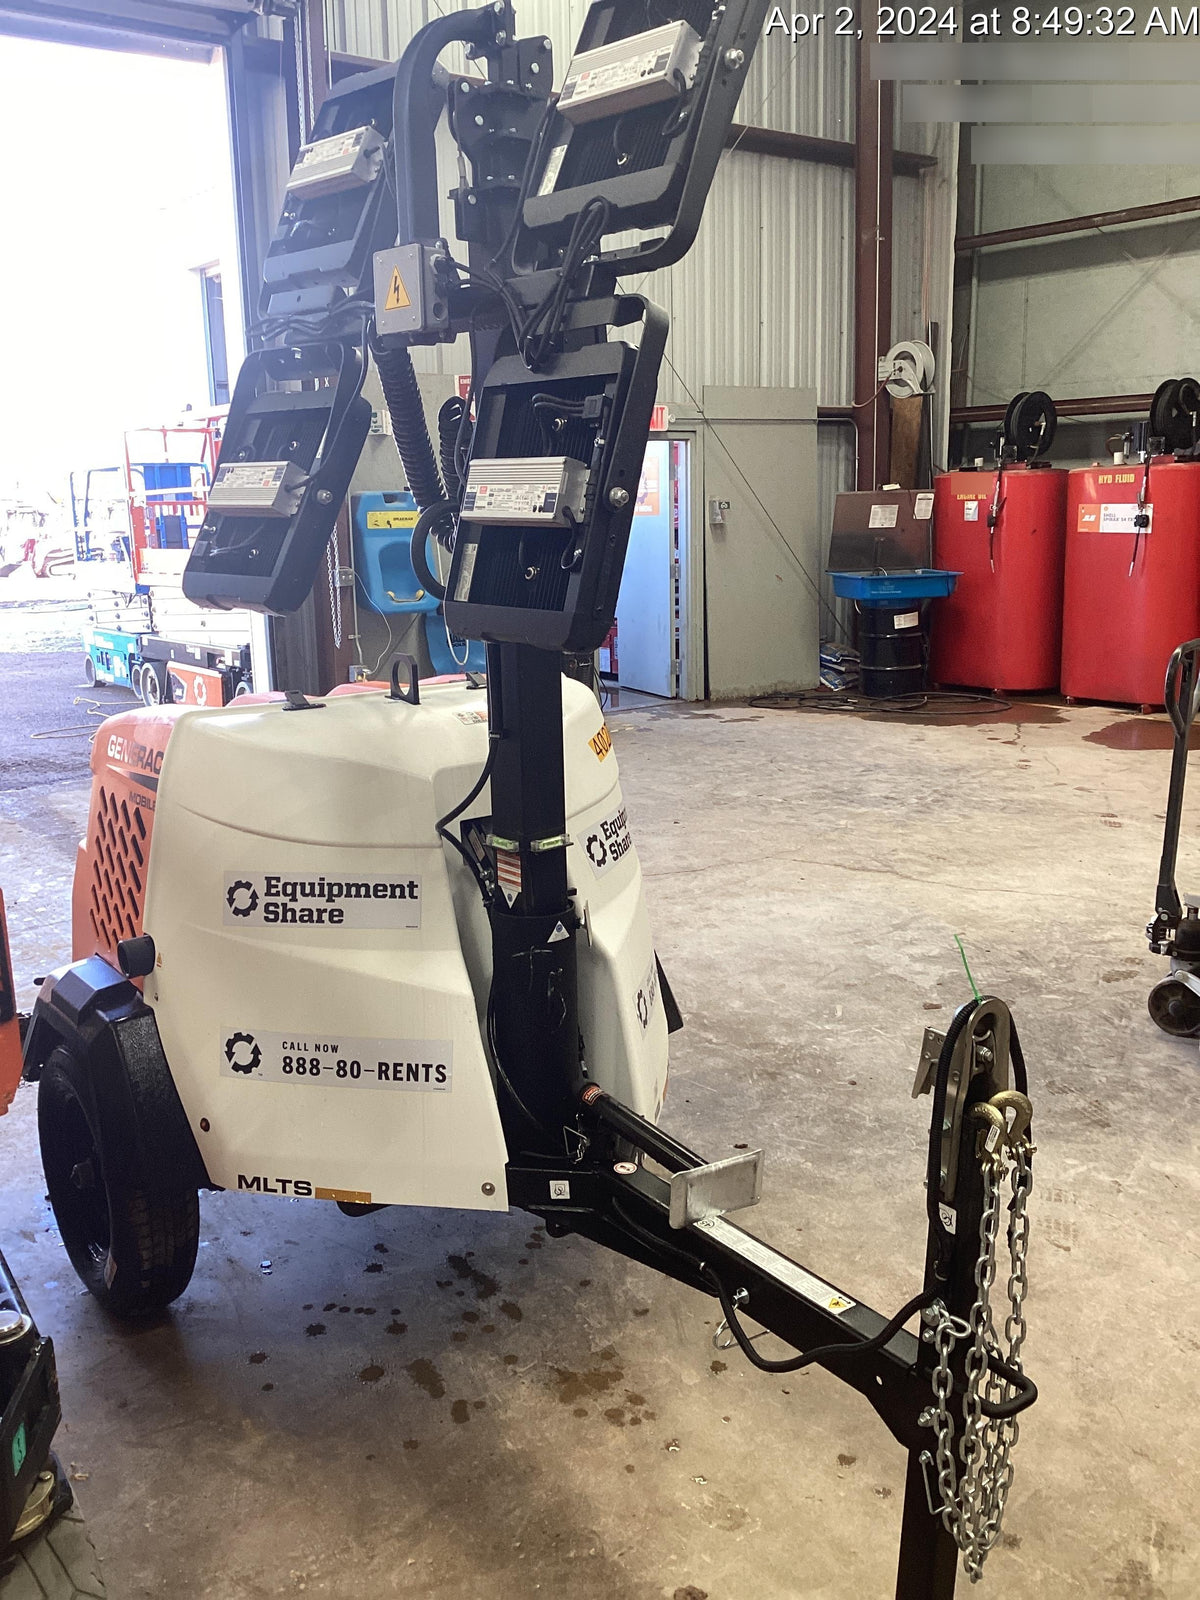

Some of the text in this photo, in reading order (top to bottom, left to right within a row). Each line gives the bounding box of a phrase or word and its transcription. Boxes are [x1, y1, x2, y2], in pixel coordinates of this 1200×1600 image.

[1098, 473, 1135, 484] HYD FLUID
[107, 734, 165, 775] GENERAC
[264, 876, 418, 903] Equipment
[263, 902, 344, 924] Share
[282, 1041, 339, 1054] CALL NOW
[282, 1055, 447, 1083] 888-80-RENTS
[237, 1174, 312, 1196] MLTS
